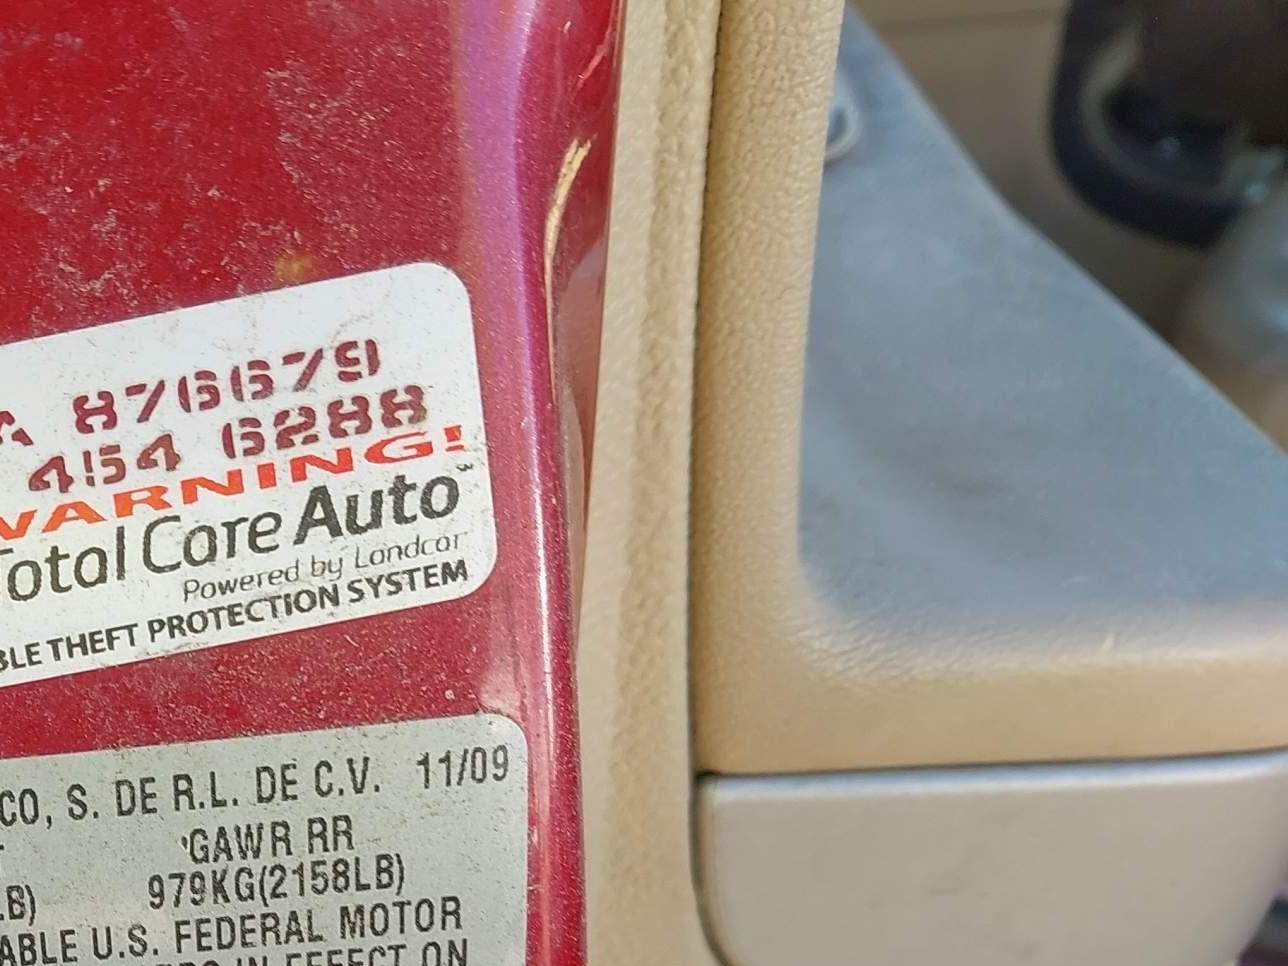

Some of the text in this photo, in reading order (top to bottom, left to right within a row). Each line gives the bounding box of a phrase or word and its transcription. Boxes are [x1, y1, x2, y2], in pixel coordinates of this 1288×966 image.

[74, 338, 381, 434] 876679
[28, 432, 181, 493] 454
[221, 384, 428, 458] 6288
[141, 510, 283, 575] Care
[293, 472, 460, 546] Auto
[182, 532, 464, 604] Powered by Landcar
[50, 623, 140, 659] THEFT
[148, 583, 341, 643] PROTECTION
[347, 559, 469, 604] SYSTEM
[66, 783, 99, 820] S.
[116, 777, 158, 816] DE
[172, 770, 239, 812] R.L.
[255, 764, 298, 802] DE
[314, 756, 381, 798] C.V.
[416, 745, 510, 790] 11/09
[188, 815, 354, 864] GAWR RR
[148, 854, 405, 910] 979KG(2158LB)
[92, 925, 158, 961] U.S.
[175, 908, 324, 955] FEDERAL
[339, 896, 463, 938] MOTOR
